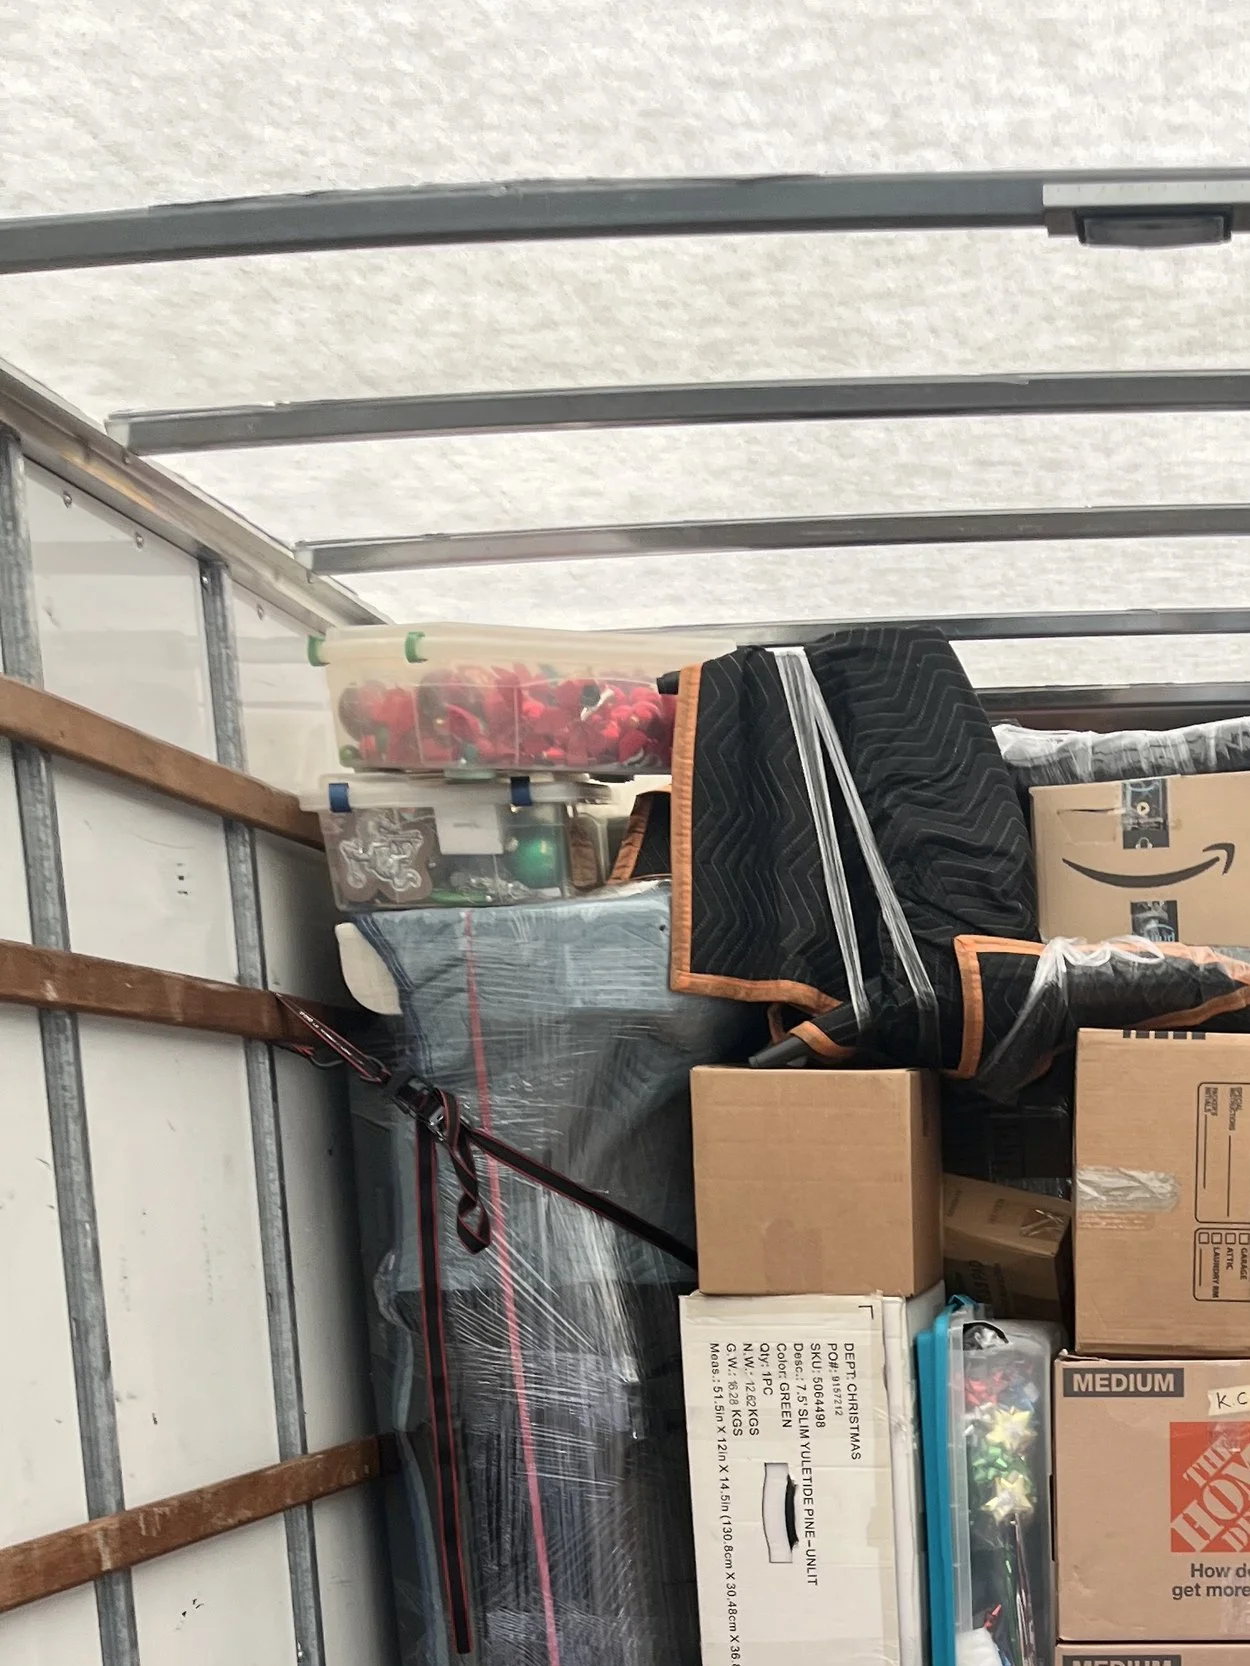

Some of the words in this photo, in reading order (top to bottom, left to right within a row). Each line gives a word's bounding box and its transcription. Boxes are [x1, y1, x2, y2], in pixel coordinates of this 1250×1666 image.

[1213, 1247, 1221, 1284] LAUNDRY
[1226, 1247, 1234, 1270] ATTIC
[1212, 1286, 1219, 1298] RM
[709, 1343, 721, 1383] Meas.:
[726, 1343, 738, 1376] G.W.:
[743, 1343, 755, 1376] N.W.:
[758, 1343, 770, 1367] Qty:
[777, 1343, 788, 1379] Color:
[793, 1343, 804, 1381] Desc.:
[810, 1343, 822, 1373] SKU:
[827, 1343, 839, 1373] PO#:
[844, 1343, 856, 1380] DEPT:
[762, 1371, 774, 1396] 1PC
[796, 1385, 808, 1407] 7.5'
[831, 1376, 843, 1416] 9157212
[1072, 1373, 1175, 1393] MEDIUM
[712, 1386, 725, 1422] 51.5in
[779, 1382, 792, 1428] GREEN
[812, 1377, 826, 1428] 5064498
[717, 1426, 727, 1434] X
[731, 1409, 743, 1436] KGS
[798, 1409, 810, 1439] SLIM
[846, 1384, 861, 1460] CHRISTMAS
[717, 1438, 728, 1461] 12in
[719, 1465, 729, 1473] X
[800, 1442, 813, 1505] YULETIDE
[719, 1478, 731, 1512] 14.5in
[719, 1514, 734, 1569] (130.8cm
[725, 1572, 735, 1580] X
[1191, 1563, 1231, 1578] How
[1172, 1584, 1202, 1600] get
[1206, 1586, 1250, 1597] more
[726, 1583, 738, 1632] 30.48cm
[729, 1635, 740, 1643] X
